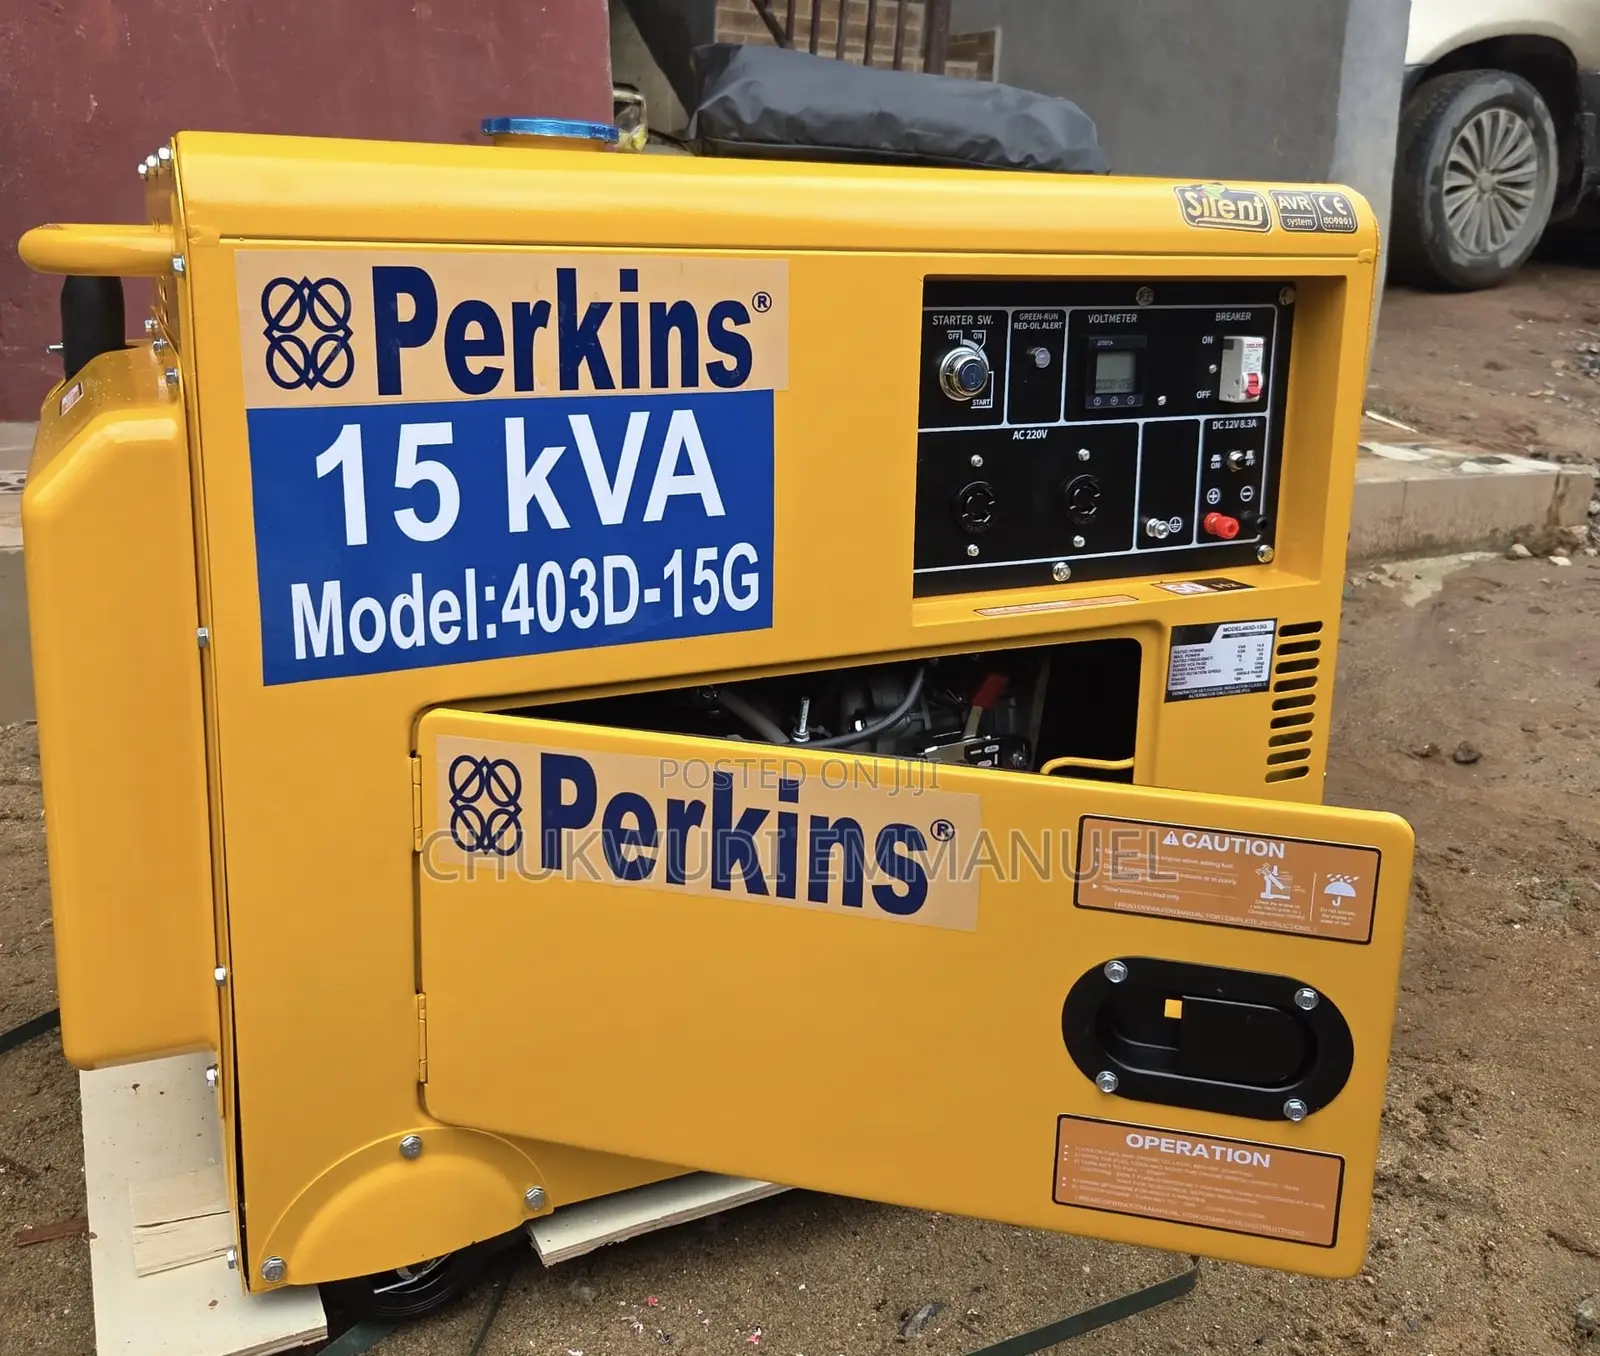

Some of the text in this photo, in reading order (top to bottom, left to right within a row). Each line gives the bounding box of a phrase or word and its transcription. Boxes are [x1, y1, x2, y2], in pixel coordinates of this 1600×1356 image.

[1184, 187, 1265, 225] Silent
[1278, 195, 1312, 212] AVR
[1286, 217, 1313, 227] system
[932, 315, 994, 325] STARTER SW.
[1019, 313, 1059, 321] GREEN-RUN
[1088, 313, 1138, 324] VOLTMETER
[1215, 312, 1252, 321] BREAKER
[1014, 321, 1063, 330] RED-OIL ALERT
[1202, 336, 1213, 344] ON
[1196, 390, 1211, 399] OFF
[972, 398, 990, 406] START
[1212, 421, 1224, 429] DC
[1225, 420, 1240, 429] 12V
[1012, 429, 1048, 440] AC 220V
[314, 409, 727, 547] 15 kVA
[290, 542, 759, 661] Model:403D-15G
[1182, 832, 1286, 859] CAUTION
[1125, 1133, 1271, 1168] OPERATION
